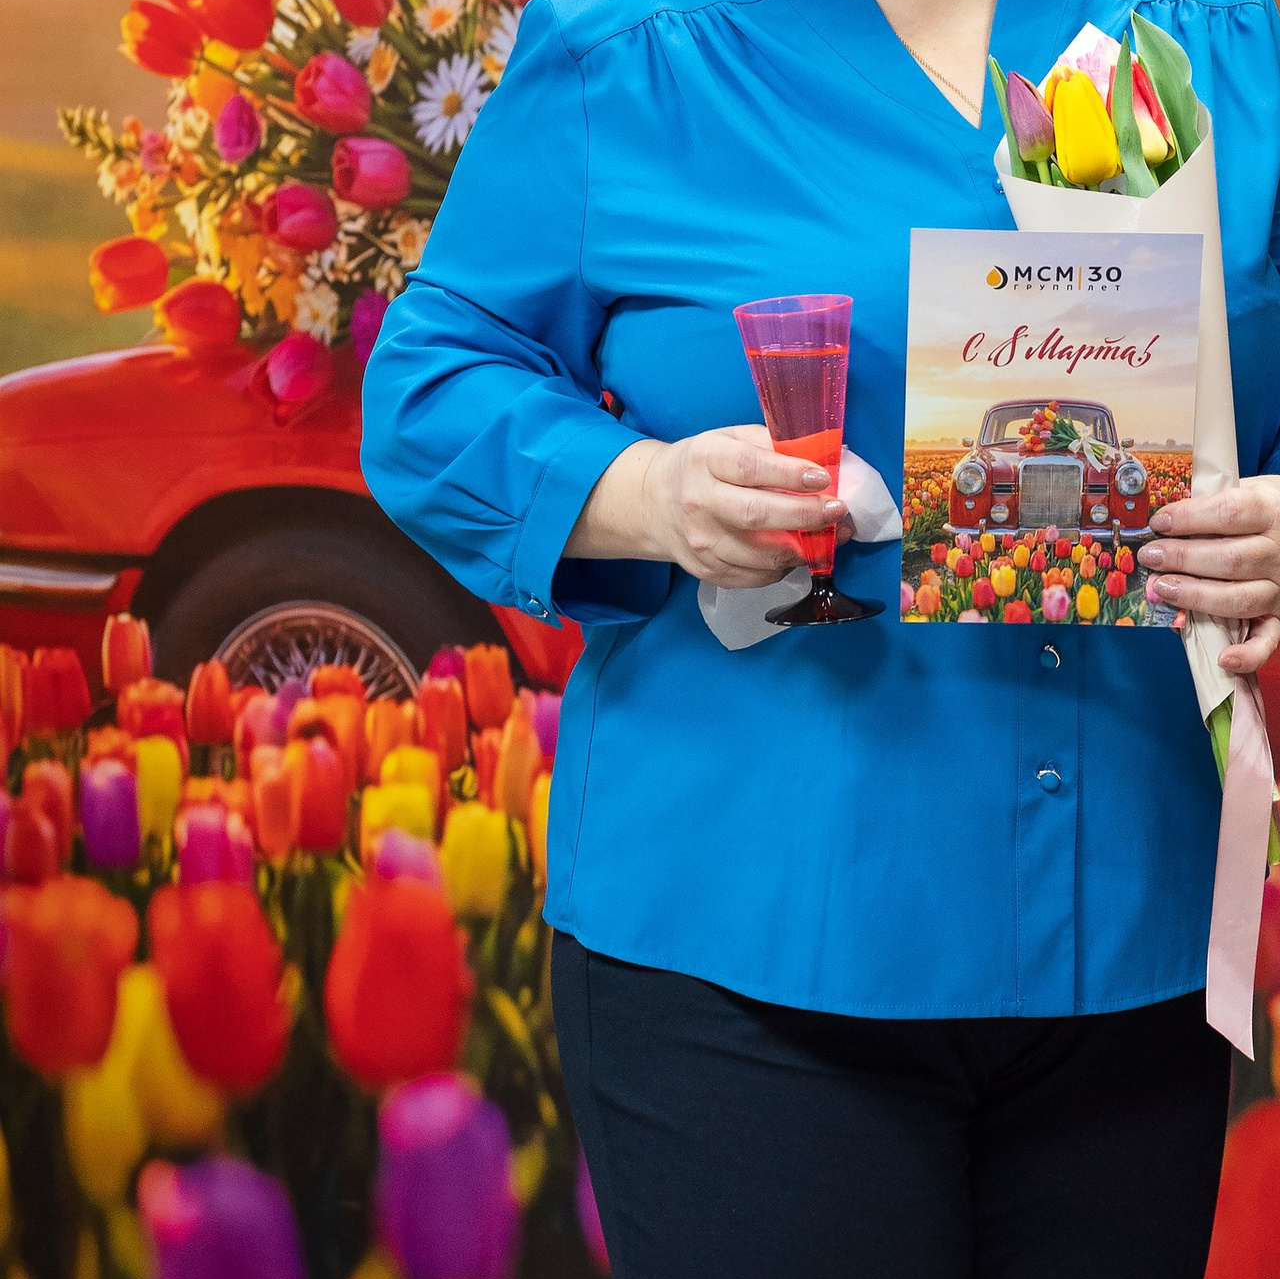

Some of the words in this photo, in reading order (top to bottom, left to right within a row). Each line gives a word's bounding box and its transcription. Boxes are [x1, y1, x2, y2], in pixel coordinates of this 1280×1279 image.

[1014, 265, 1074, 282] МСМ
[1088, 266, 1122, 283] 30
[1088, 284, 1121, 292] лет
[962, 332, 986, 363] С
[987, 324, 1029, 368] 8
[1024, 327, 1161, 375] Марта!
